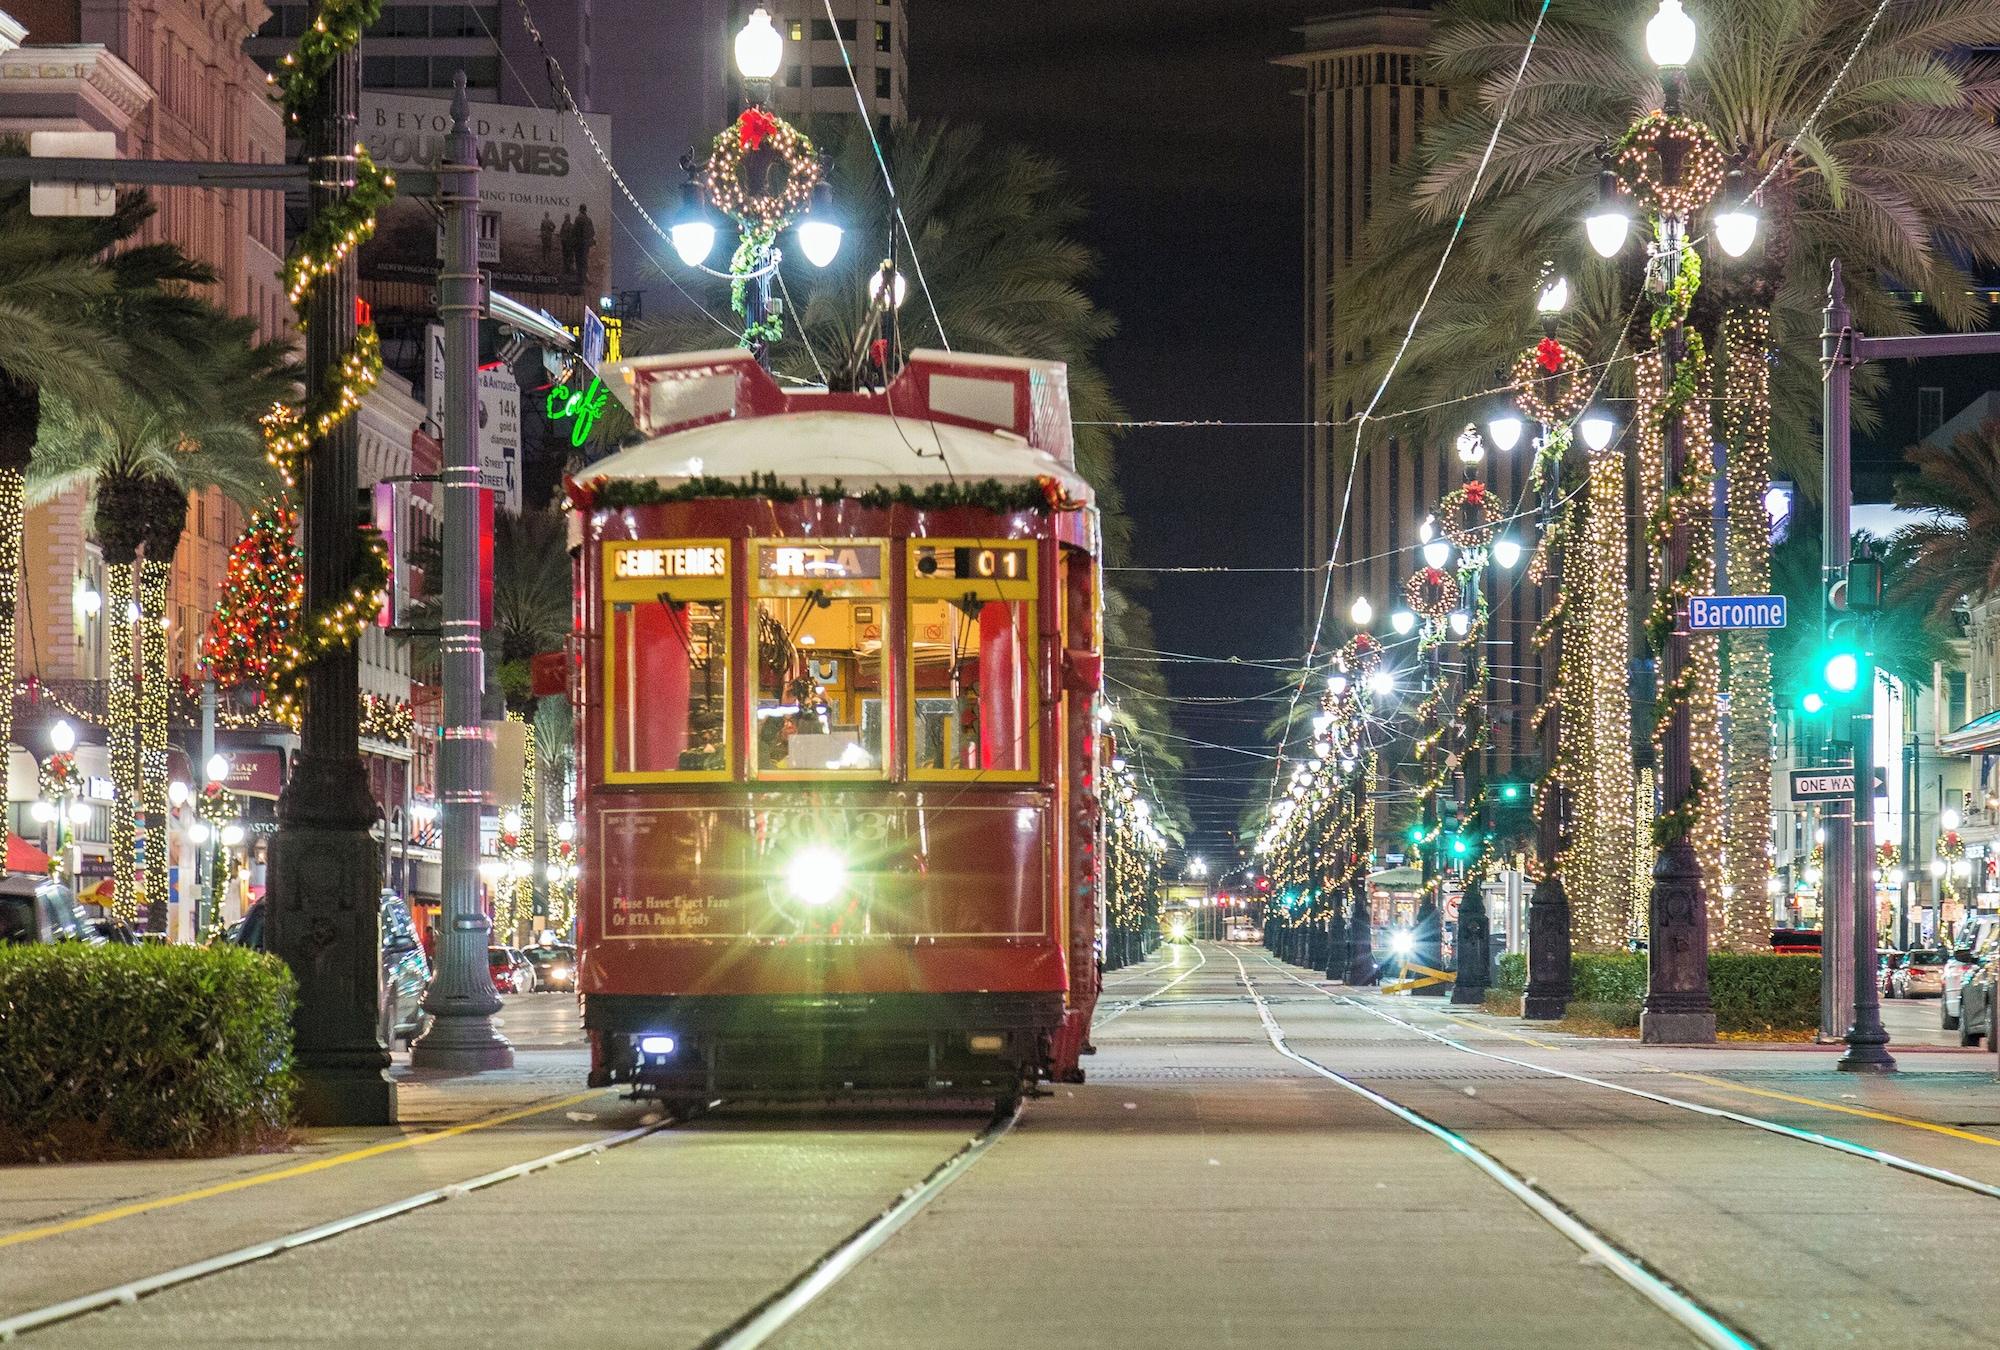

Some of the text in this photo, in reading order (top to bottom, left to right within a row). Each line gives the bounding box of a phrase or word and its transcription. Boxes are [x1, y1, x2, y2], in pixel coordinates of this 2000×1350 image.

[375, 107, 558, 143] BEYOD ALL
[369, 134, 570, 178] BOUARIES
[509, 193, 532, 204] TOM
[535, 195, 570, 207] HANKS
[534, 276, 559, 284] STREETS
[615, 548, 725, 577] CEMETERIES
[776, 548, 862, 577] RTA
[1694, 600, 1782, 626] Baronne
[1801, 779, 1827, 792] ONE
[612, 897, 642, 909] Please
[646, 896, 673, 909] Have
[707, 895, 730, 908] Fare
[612, 913, 626, 926] Or
[629, 913, 650, 926] RTA
